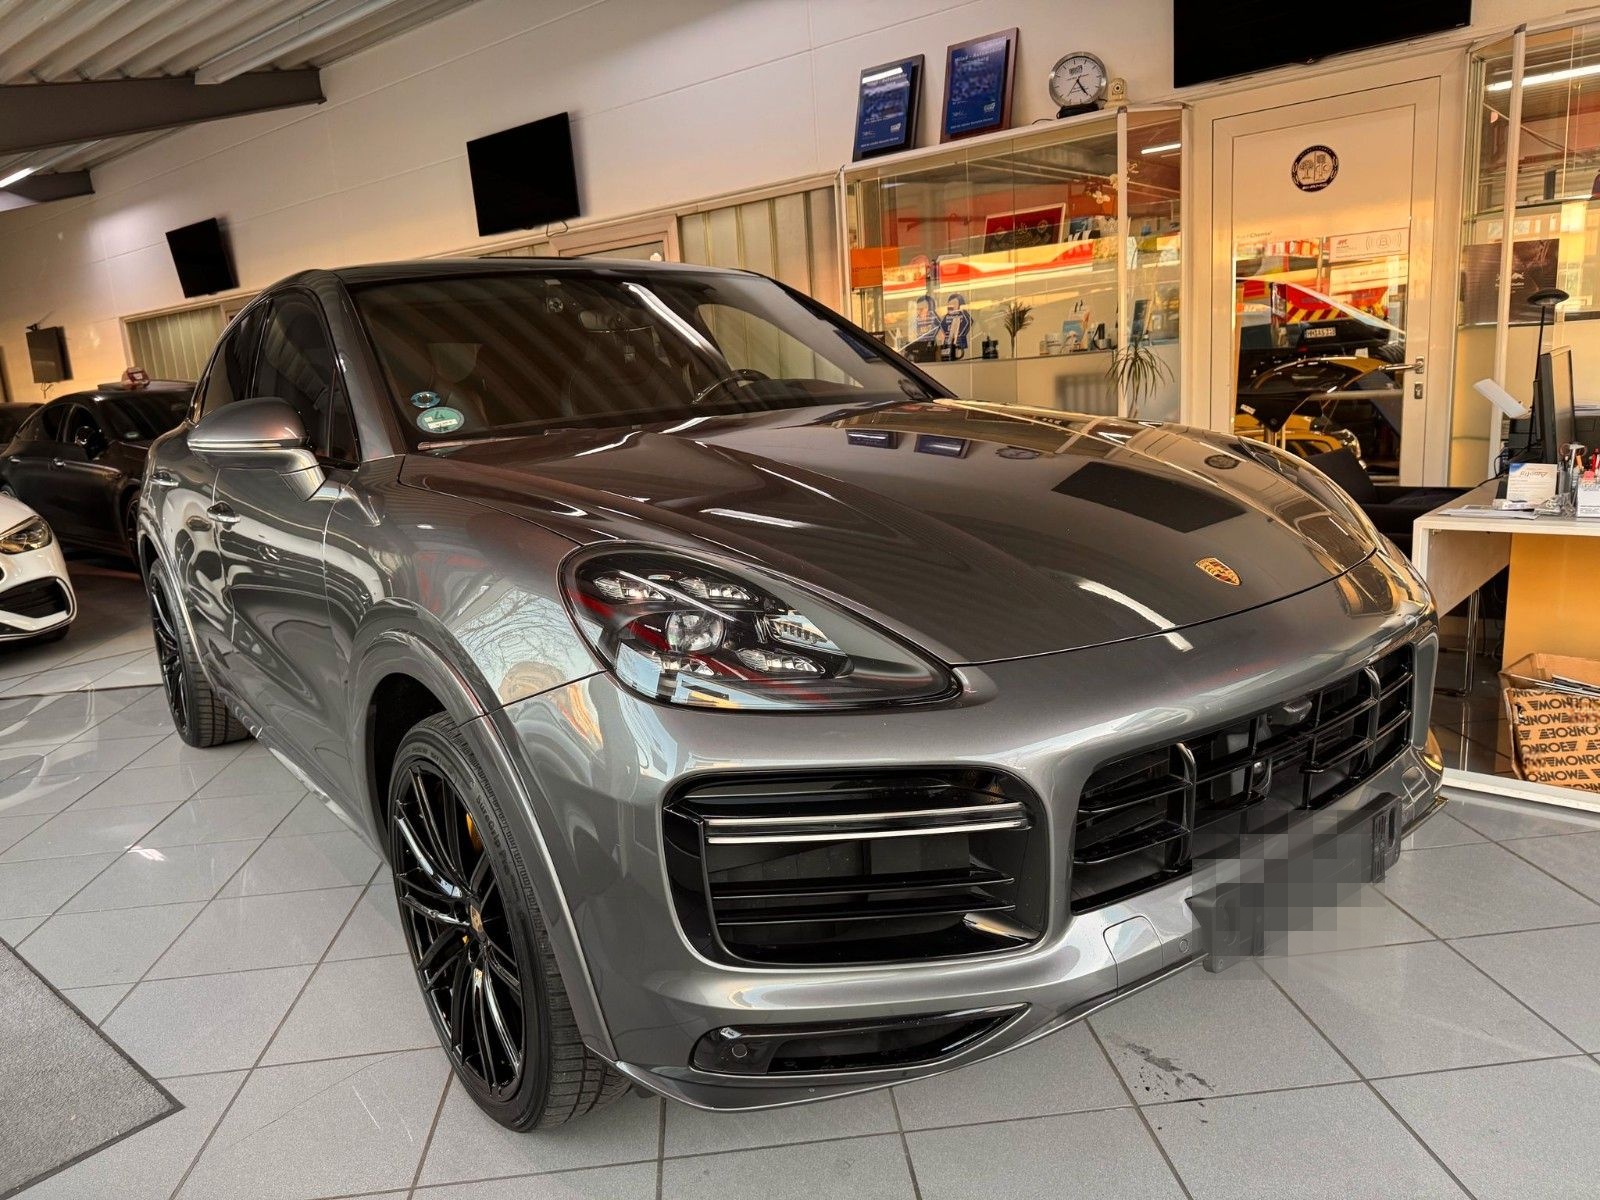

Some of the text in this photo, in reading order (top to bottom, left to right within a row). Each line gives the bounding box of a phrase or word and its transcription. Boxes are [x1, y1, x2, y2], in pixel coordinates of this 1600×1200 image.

[1520, 713, 1560, 726] MONR
[1548, 727, 1600, 739] ONROE
[1520, 741, 1569, 753] ONROE
[1527, 770, 1578, 782] MONRO
[476, 794, 501, 849] SureGrip
